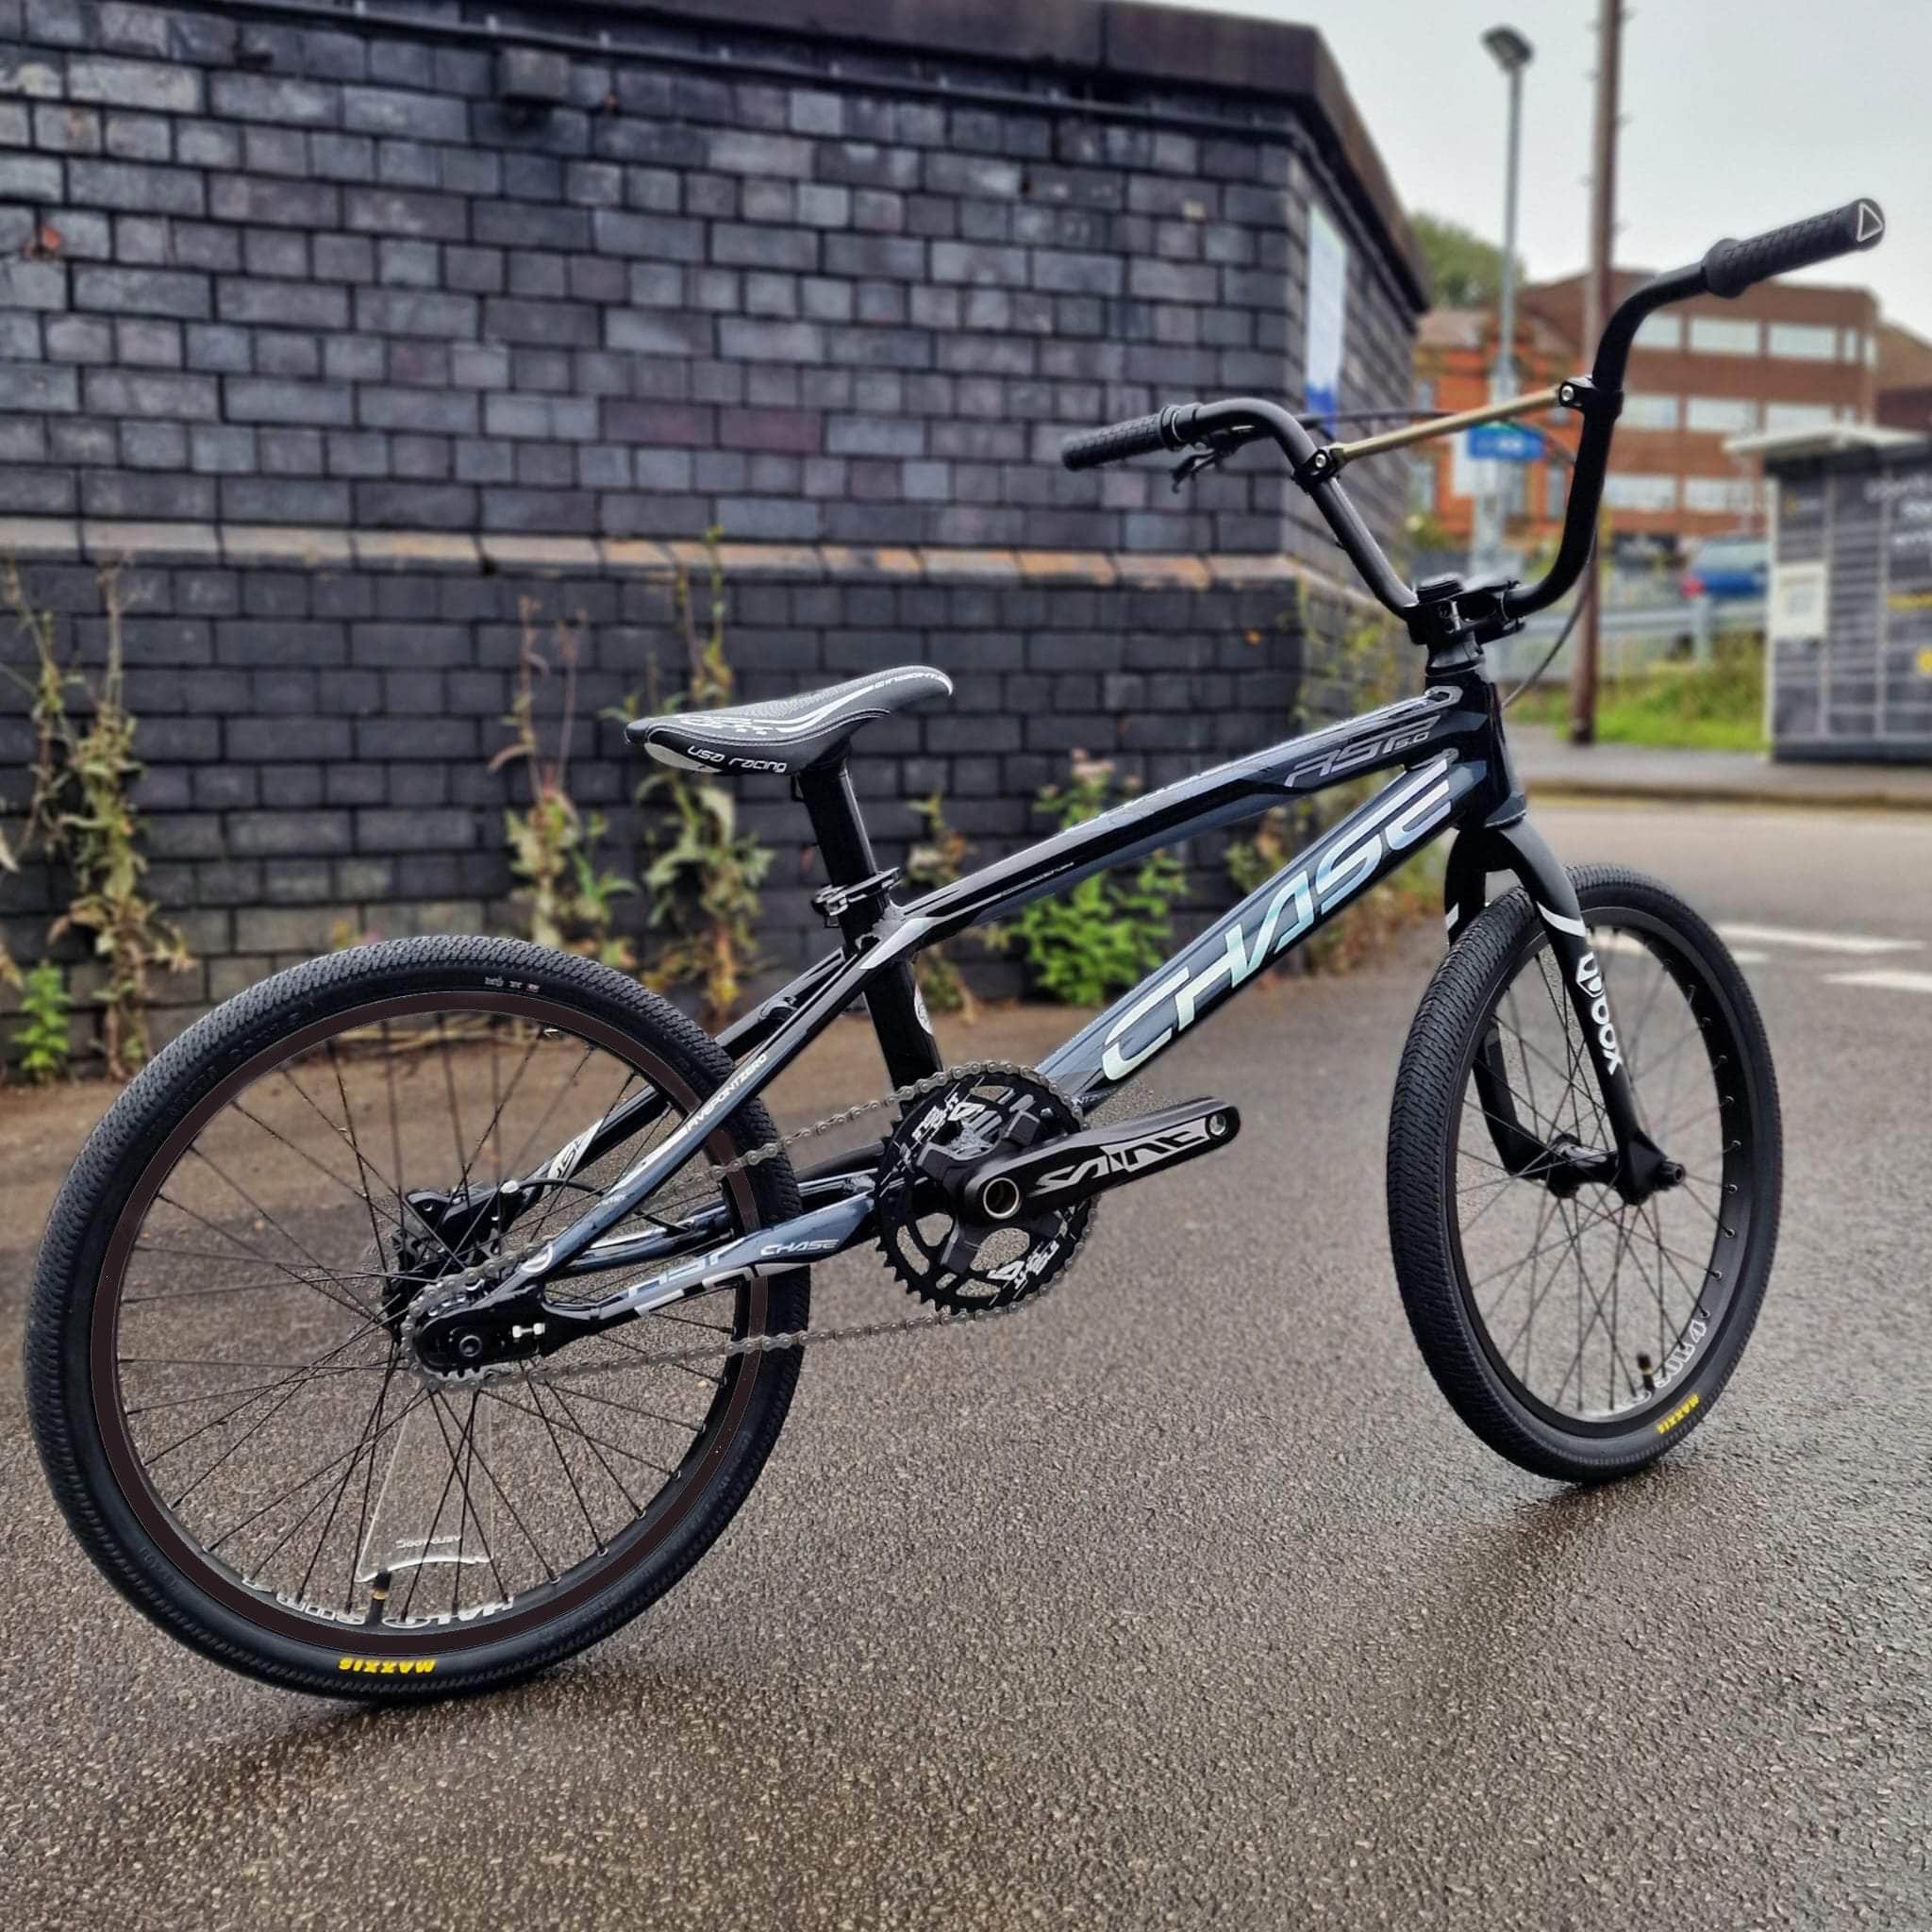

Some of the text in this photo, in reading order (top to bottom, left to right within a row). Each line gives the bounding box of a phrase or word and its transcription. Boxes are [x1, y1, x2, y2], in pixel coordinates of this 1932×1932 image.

[1101, 758, 1452, 1081] CHASE
[760, 1239, 840, 1257] CHASE
[338, 1657, 437, 1674] MAXXIS
